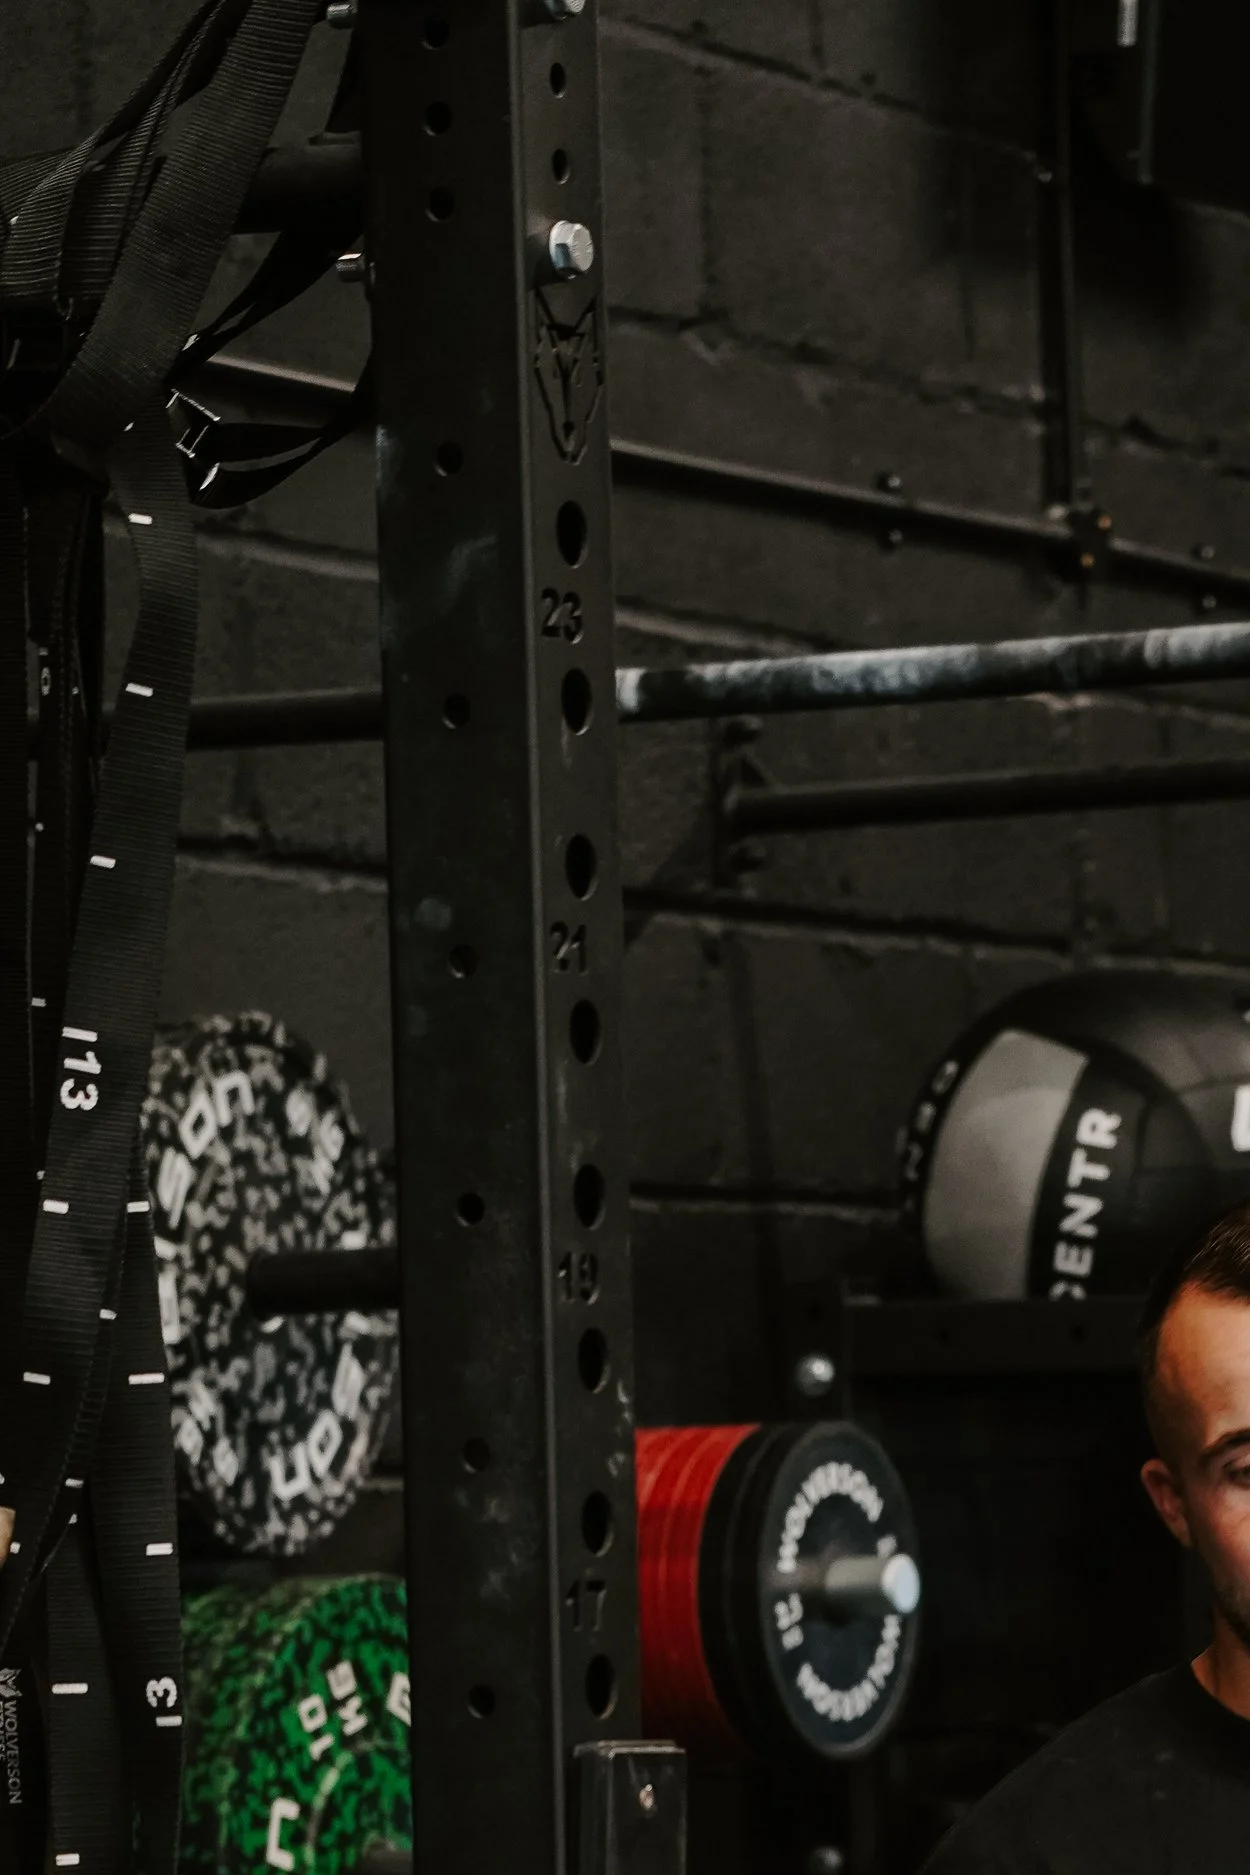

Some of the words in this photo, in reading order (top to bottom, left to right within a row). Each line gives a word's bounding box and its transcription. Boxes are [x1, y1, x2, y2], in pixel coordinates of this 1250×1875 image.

[540, 587, 584, 644] 23
[60, 1051, 102, 1111] 13
[4, 1699, 23, 1804] WOLVERSON
